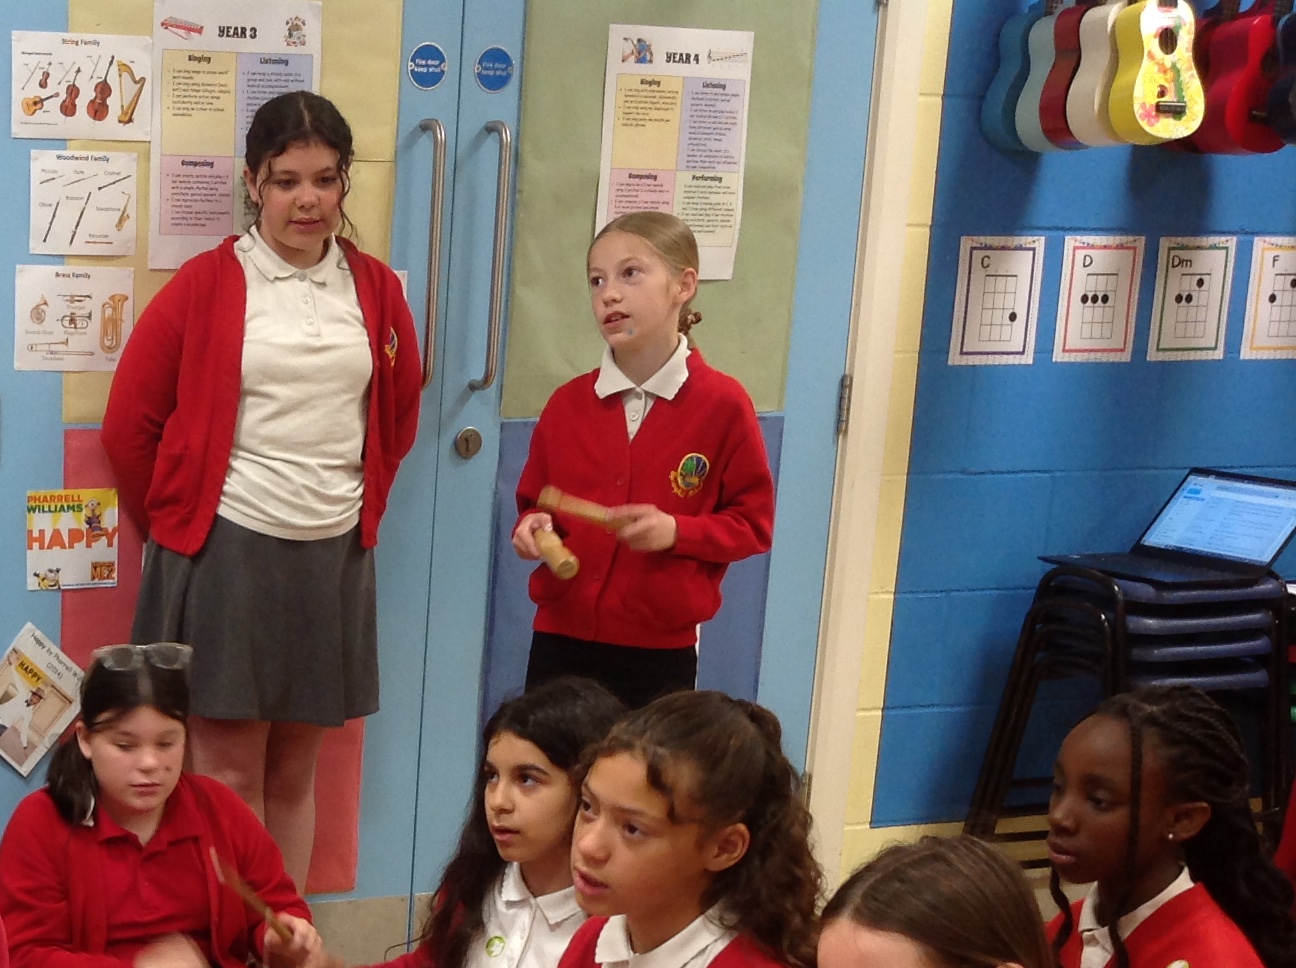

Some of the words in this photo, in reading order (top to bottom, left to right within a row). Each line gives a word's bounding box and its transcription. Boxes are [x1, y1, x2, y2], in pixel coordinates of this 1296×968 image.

[218, 26, 247, 39] YEAR
[249, 27, 257, 39] 3
[62, 38, 79, 46] String
[80, 39, 100, 47] Family
[260, 57, 289, 66] Listening
[666, 52, 690, 64] YEAR
[692, 54, 700, 64] 4
[56, 154, 89, 162] Woodwind
[91, 155, 110, 163] Family
[980, 255, 990, 268] C
[1082, 255, 1093, 268] D
[1172, 256, 1192, 268] Dm
[1272, 256, 1280, 268] F
[72, 272, 90, 280] Family
[27, 494, 83, 504] PHARRELL
[26, 503, 83, 514] WILLIAMS
[27, 526, 118, 550] HAPPY
[31, 632, 46, 650] Happy
[46, 648, 53, 656] by
[18, 660, 42, 682] HAPPY
